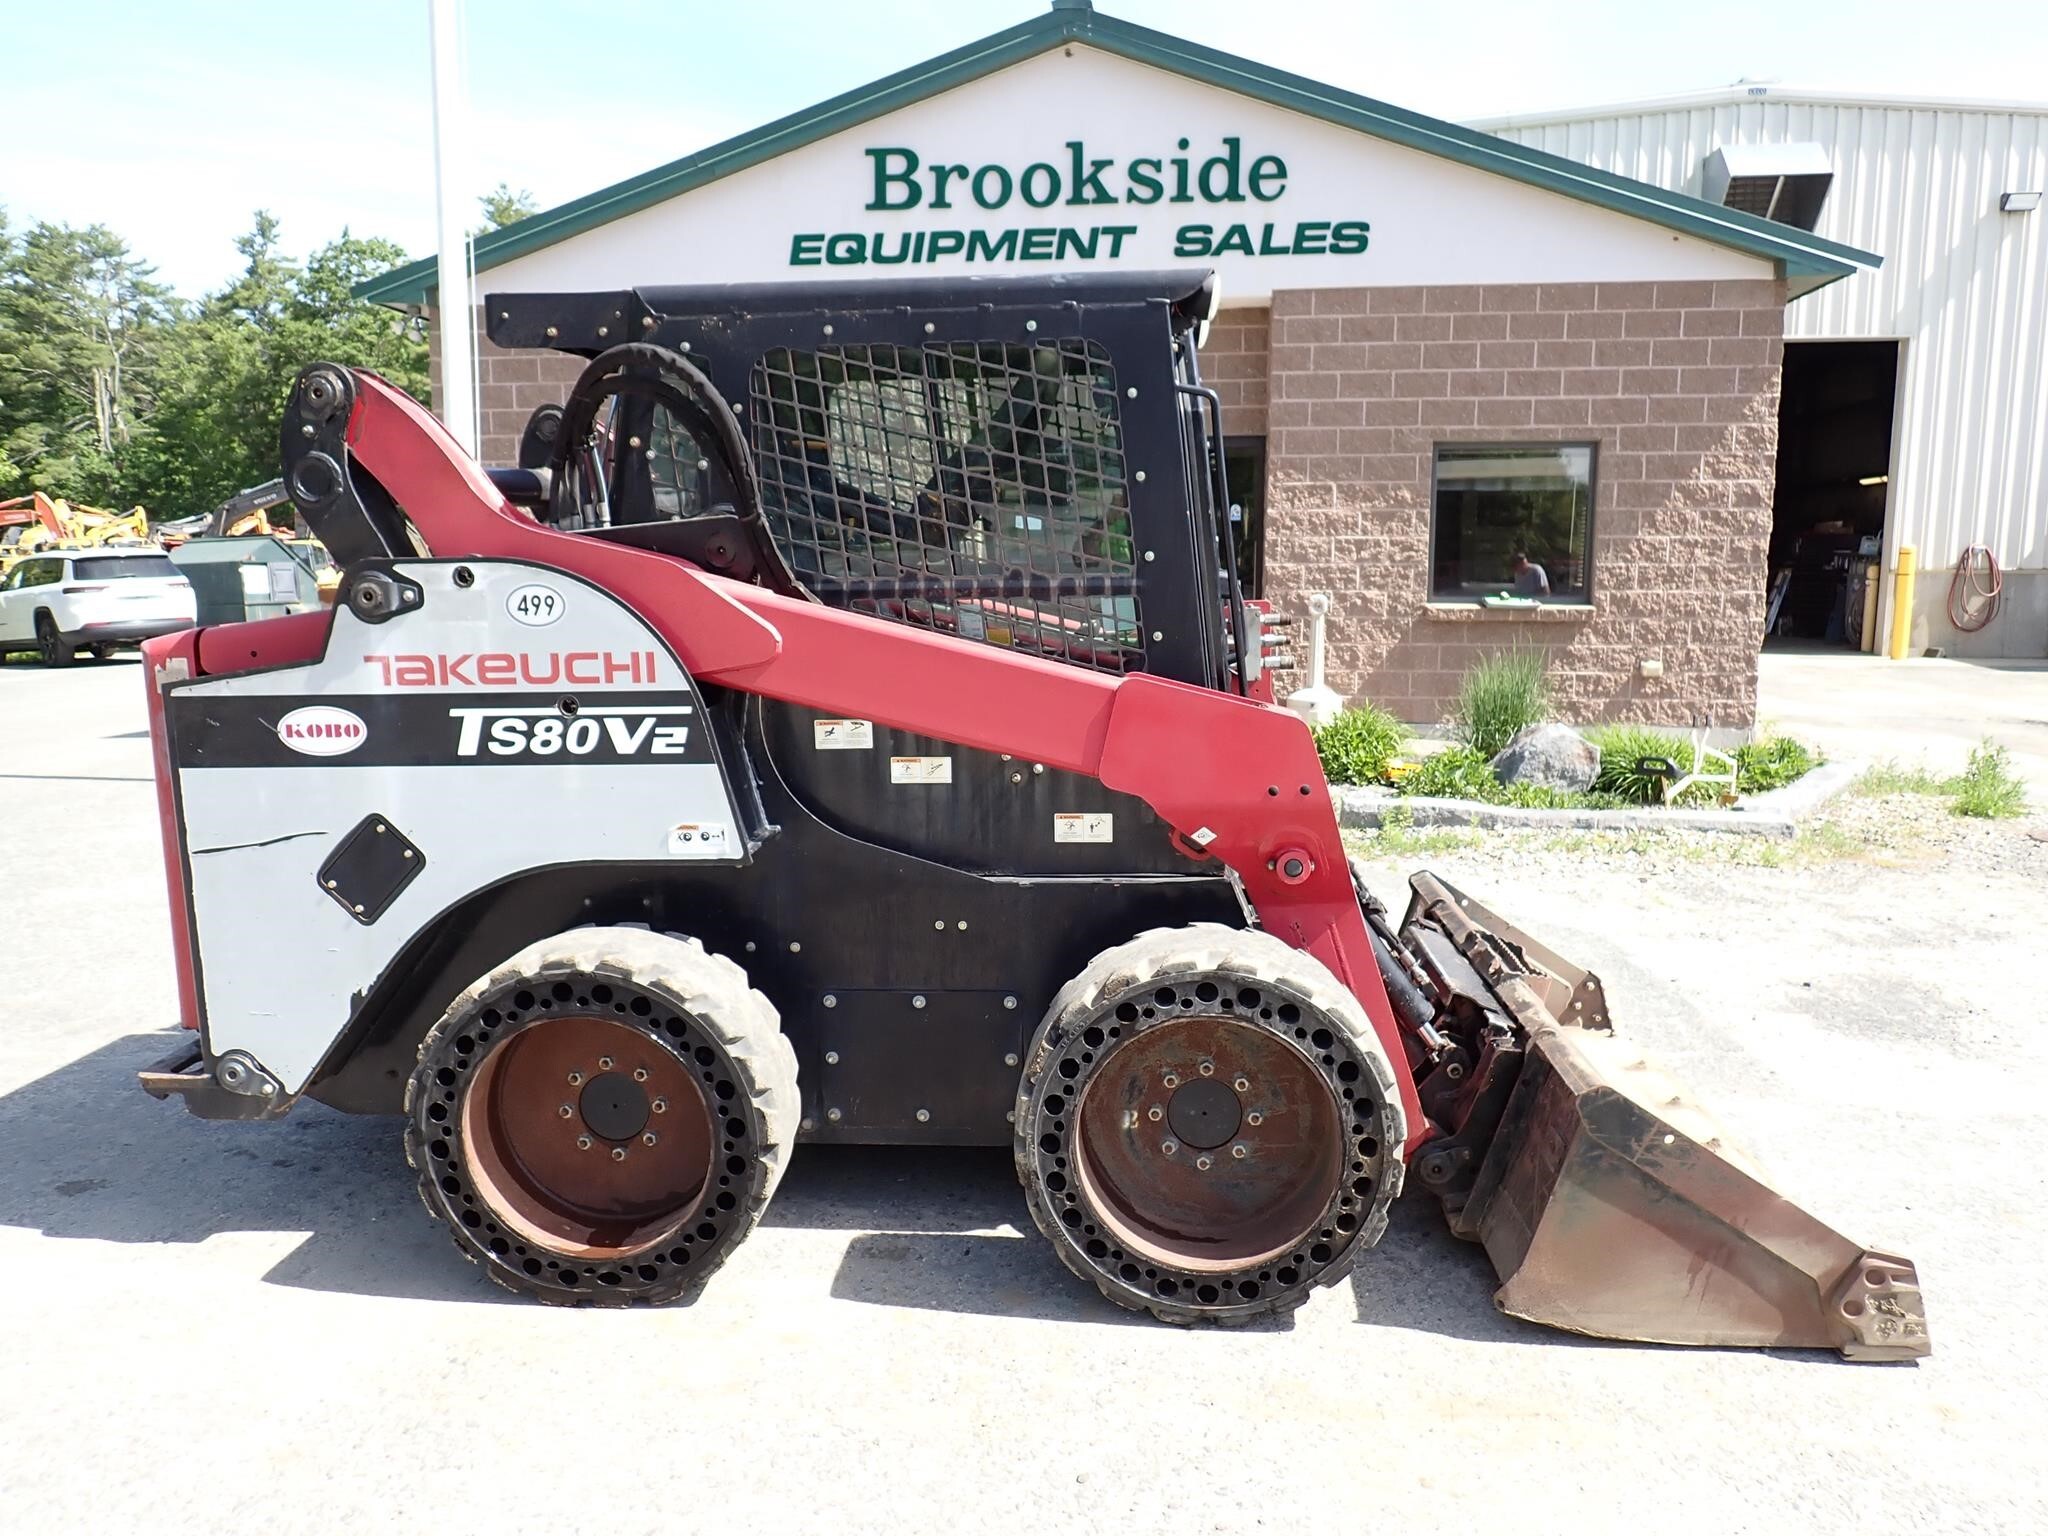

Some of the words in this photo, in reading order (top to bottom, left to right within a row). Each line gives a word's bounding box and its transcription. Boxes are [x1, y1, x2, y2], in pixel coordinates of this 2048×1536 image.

[864, 136, 1289, 212] Brookside
[789, 225, 1138, 267] EQUIPMENT
[1173, 221, 1371, 259] SALES
[516, 594, 556, 616] 499
[284, 723, 363, 739] KOBO
